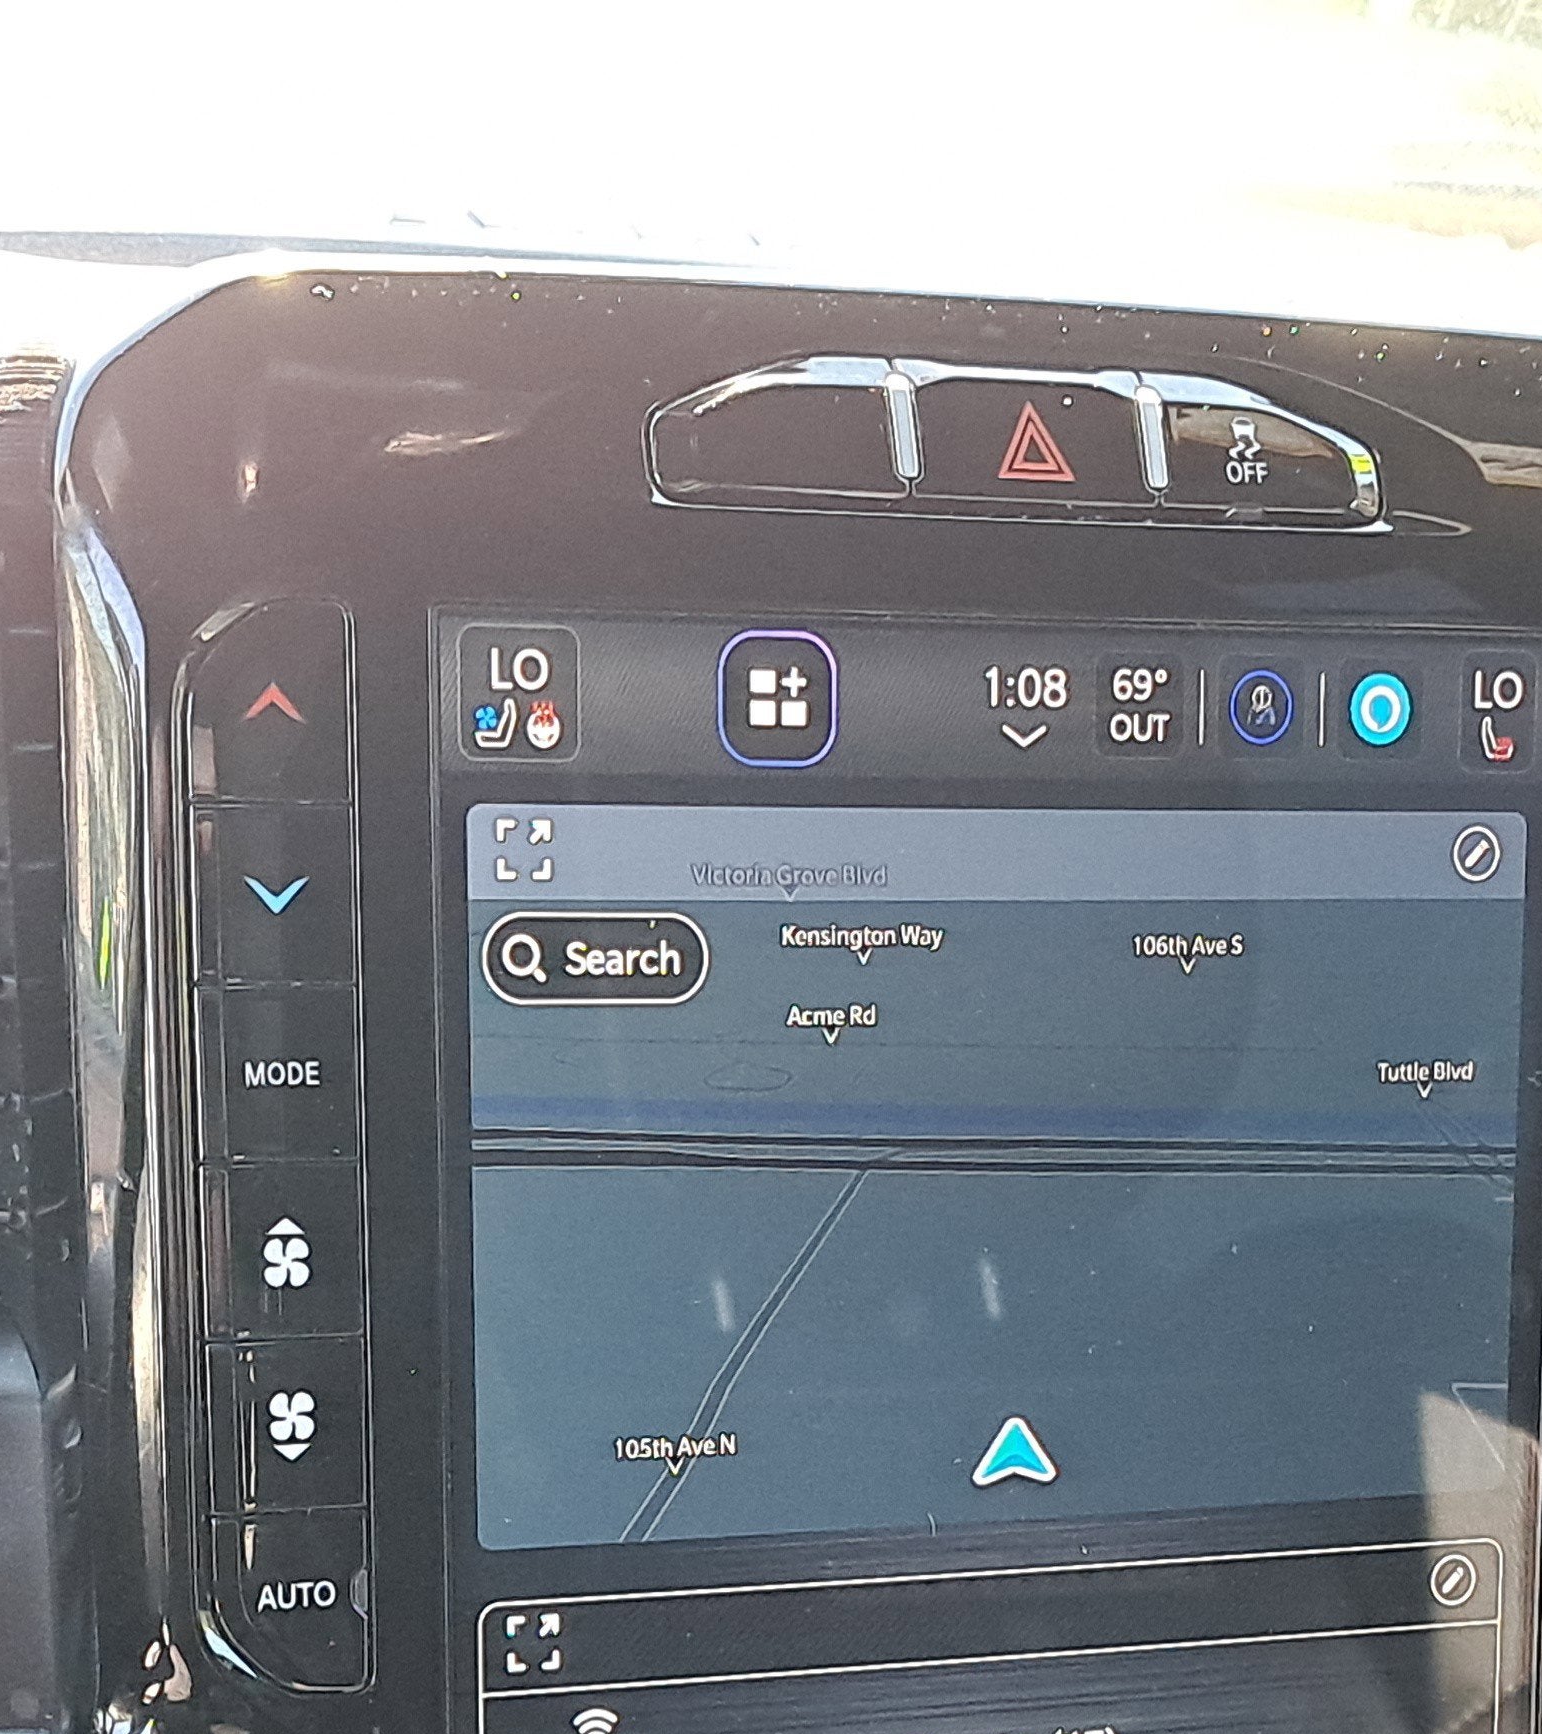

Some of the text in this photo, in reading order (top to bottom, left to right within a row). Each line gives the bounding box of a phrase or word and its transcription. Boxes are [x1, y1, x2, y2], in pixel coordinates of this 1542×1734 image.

[1224, 461, 1269, 486] OFF
[489, 646, 550, 691] LO
[985, 665, 1068, 708] 1:08
[1474, 671, 1523, 709] LO
[1110, 712, 1171, 742] OUT
[690, 862, 888, 886] Victoria Grove Blvd
[780, 924, 944, 951] Kensington Way
[1132, 935, 1245, 956] 106th Ave S
[565, 939, 682, 977] Search
[785, 1003, 877, 1027] Acme Rd
[244, 1061, 321, 1088] MODE
[1377, 1061, 1474, 1081] Tuttle Blvd
[615, 1434, 737, 1460] 105th Ave N
[258, 1582, 337, 1612] AUTO
